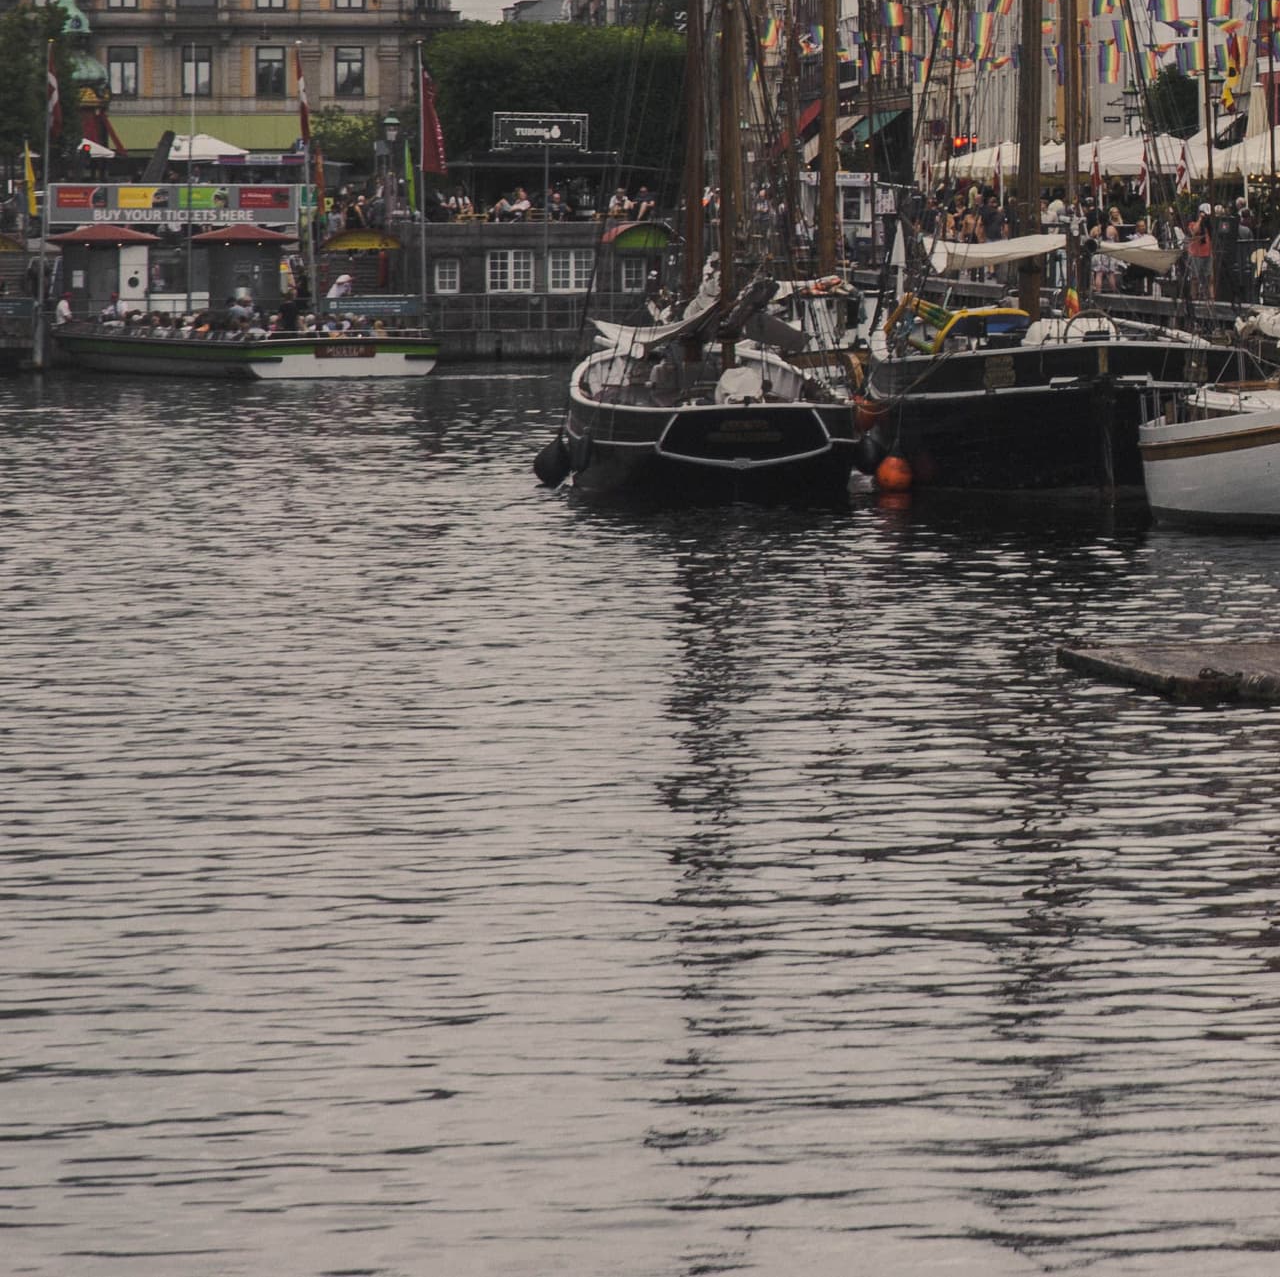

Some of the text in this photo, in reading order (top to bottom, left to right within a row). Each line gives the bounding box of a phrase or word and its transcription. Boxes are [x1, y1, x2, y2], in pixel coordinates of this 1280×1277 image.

[93, 209, 122, 221] BUY
[123, 209, 164, 221] YOUR
[219, 209, 254, 221] HERE
